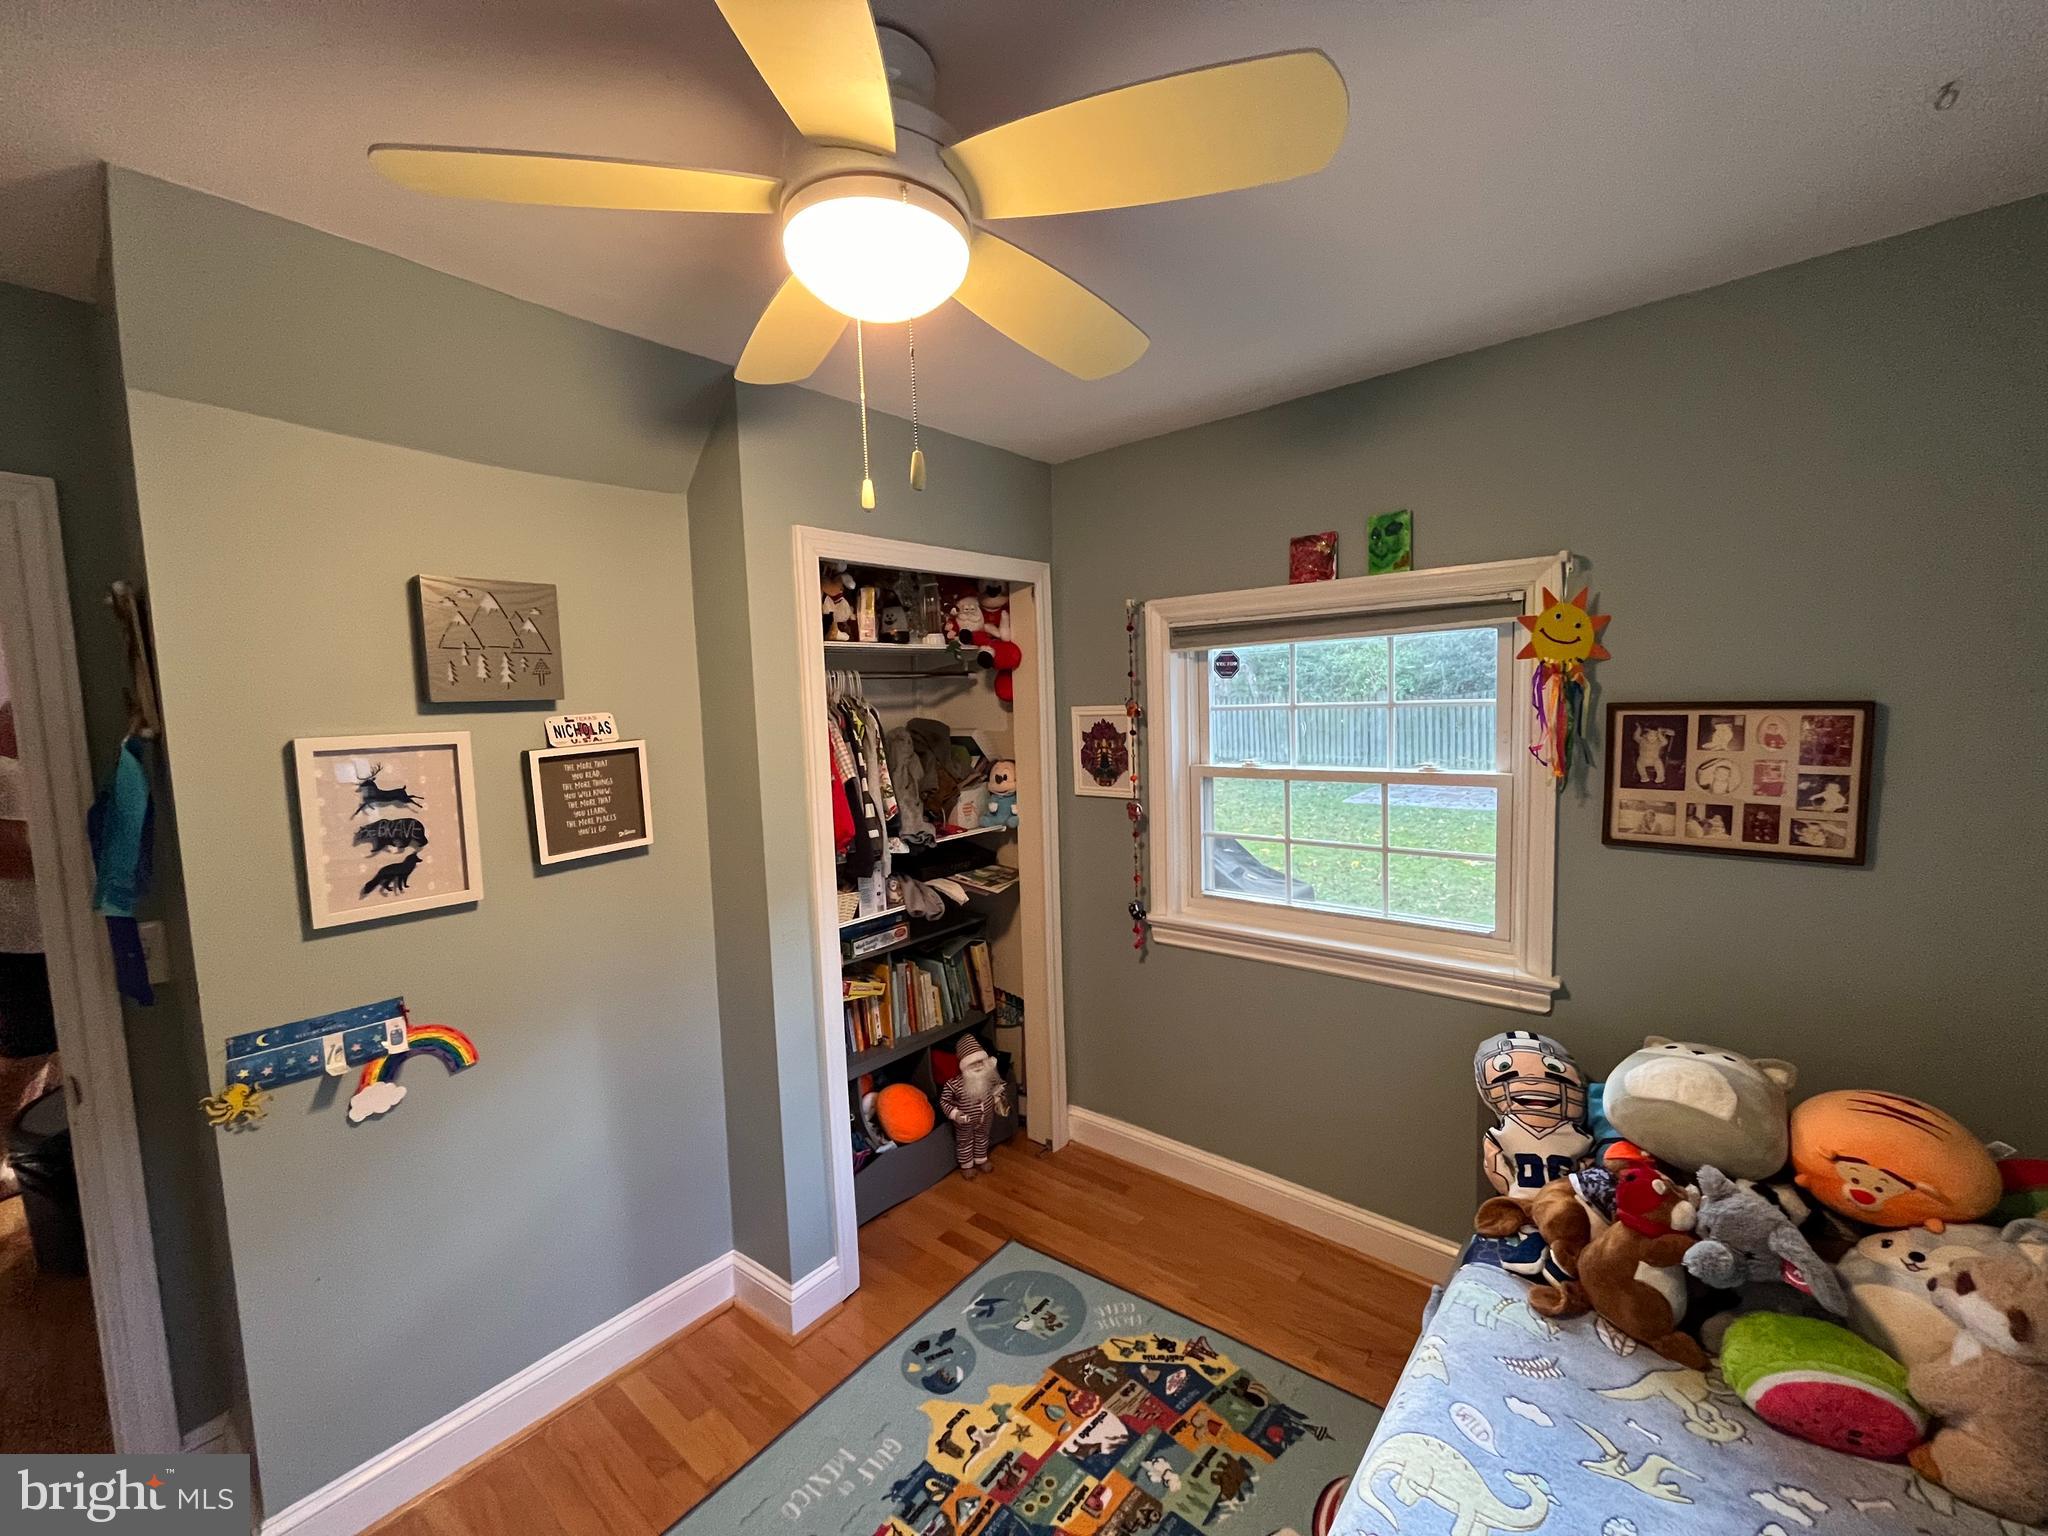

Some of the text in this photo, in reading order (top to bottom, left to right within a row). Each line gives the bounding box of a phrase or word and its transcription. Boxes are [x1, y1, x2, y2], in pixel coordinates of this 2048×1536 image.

[553, 720, 612, 739] NICHOLAS
[1143, 1354, 1185, 1363] california
[1078, 1410, 1108, 1439] colorado
[1454, 1405, 1491, 1443] WILD
[857, 1438, 902, 1487] GULF
[781, 1448, 857, 1520] MEXICO
